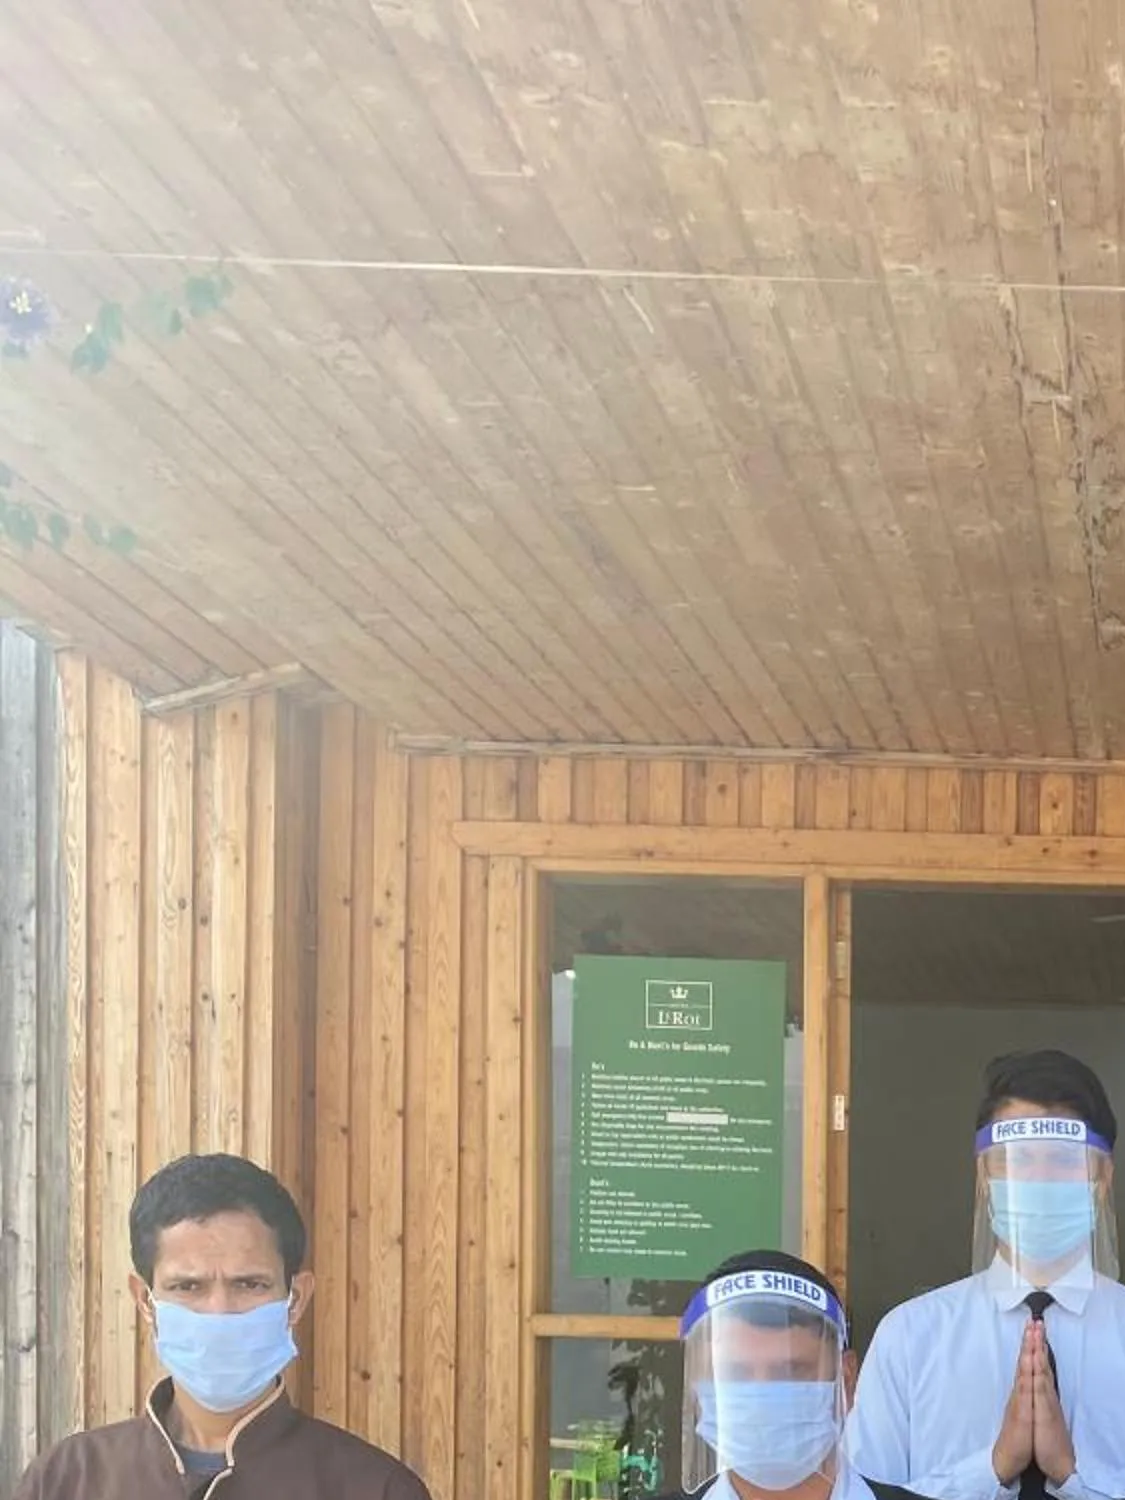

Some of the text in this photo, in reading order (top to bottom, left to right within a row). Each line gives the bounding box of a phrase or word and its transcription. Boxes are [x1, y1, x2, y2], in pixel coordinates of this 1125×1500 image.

[997, 1120, 1081, 1138] FACE SHIELD
[714, 1274, 822, 1301] FACE SHIELD
